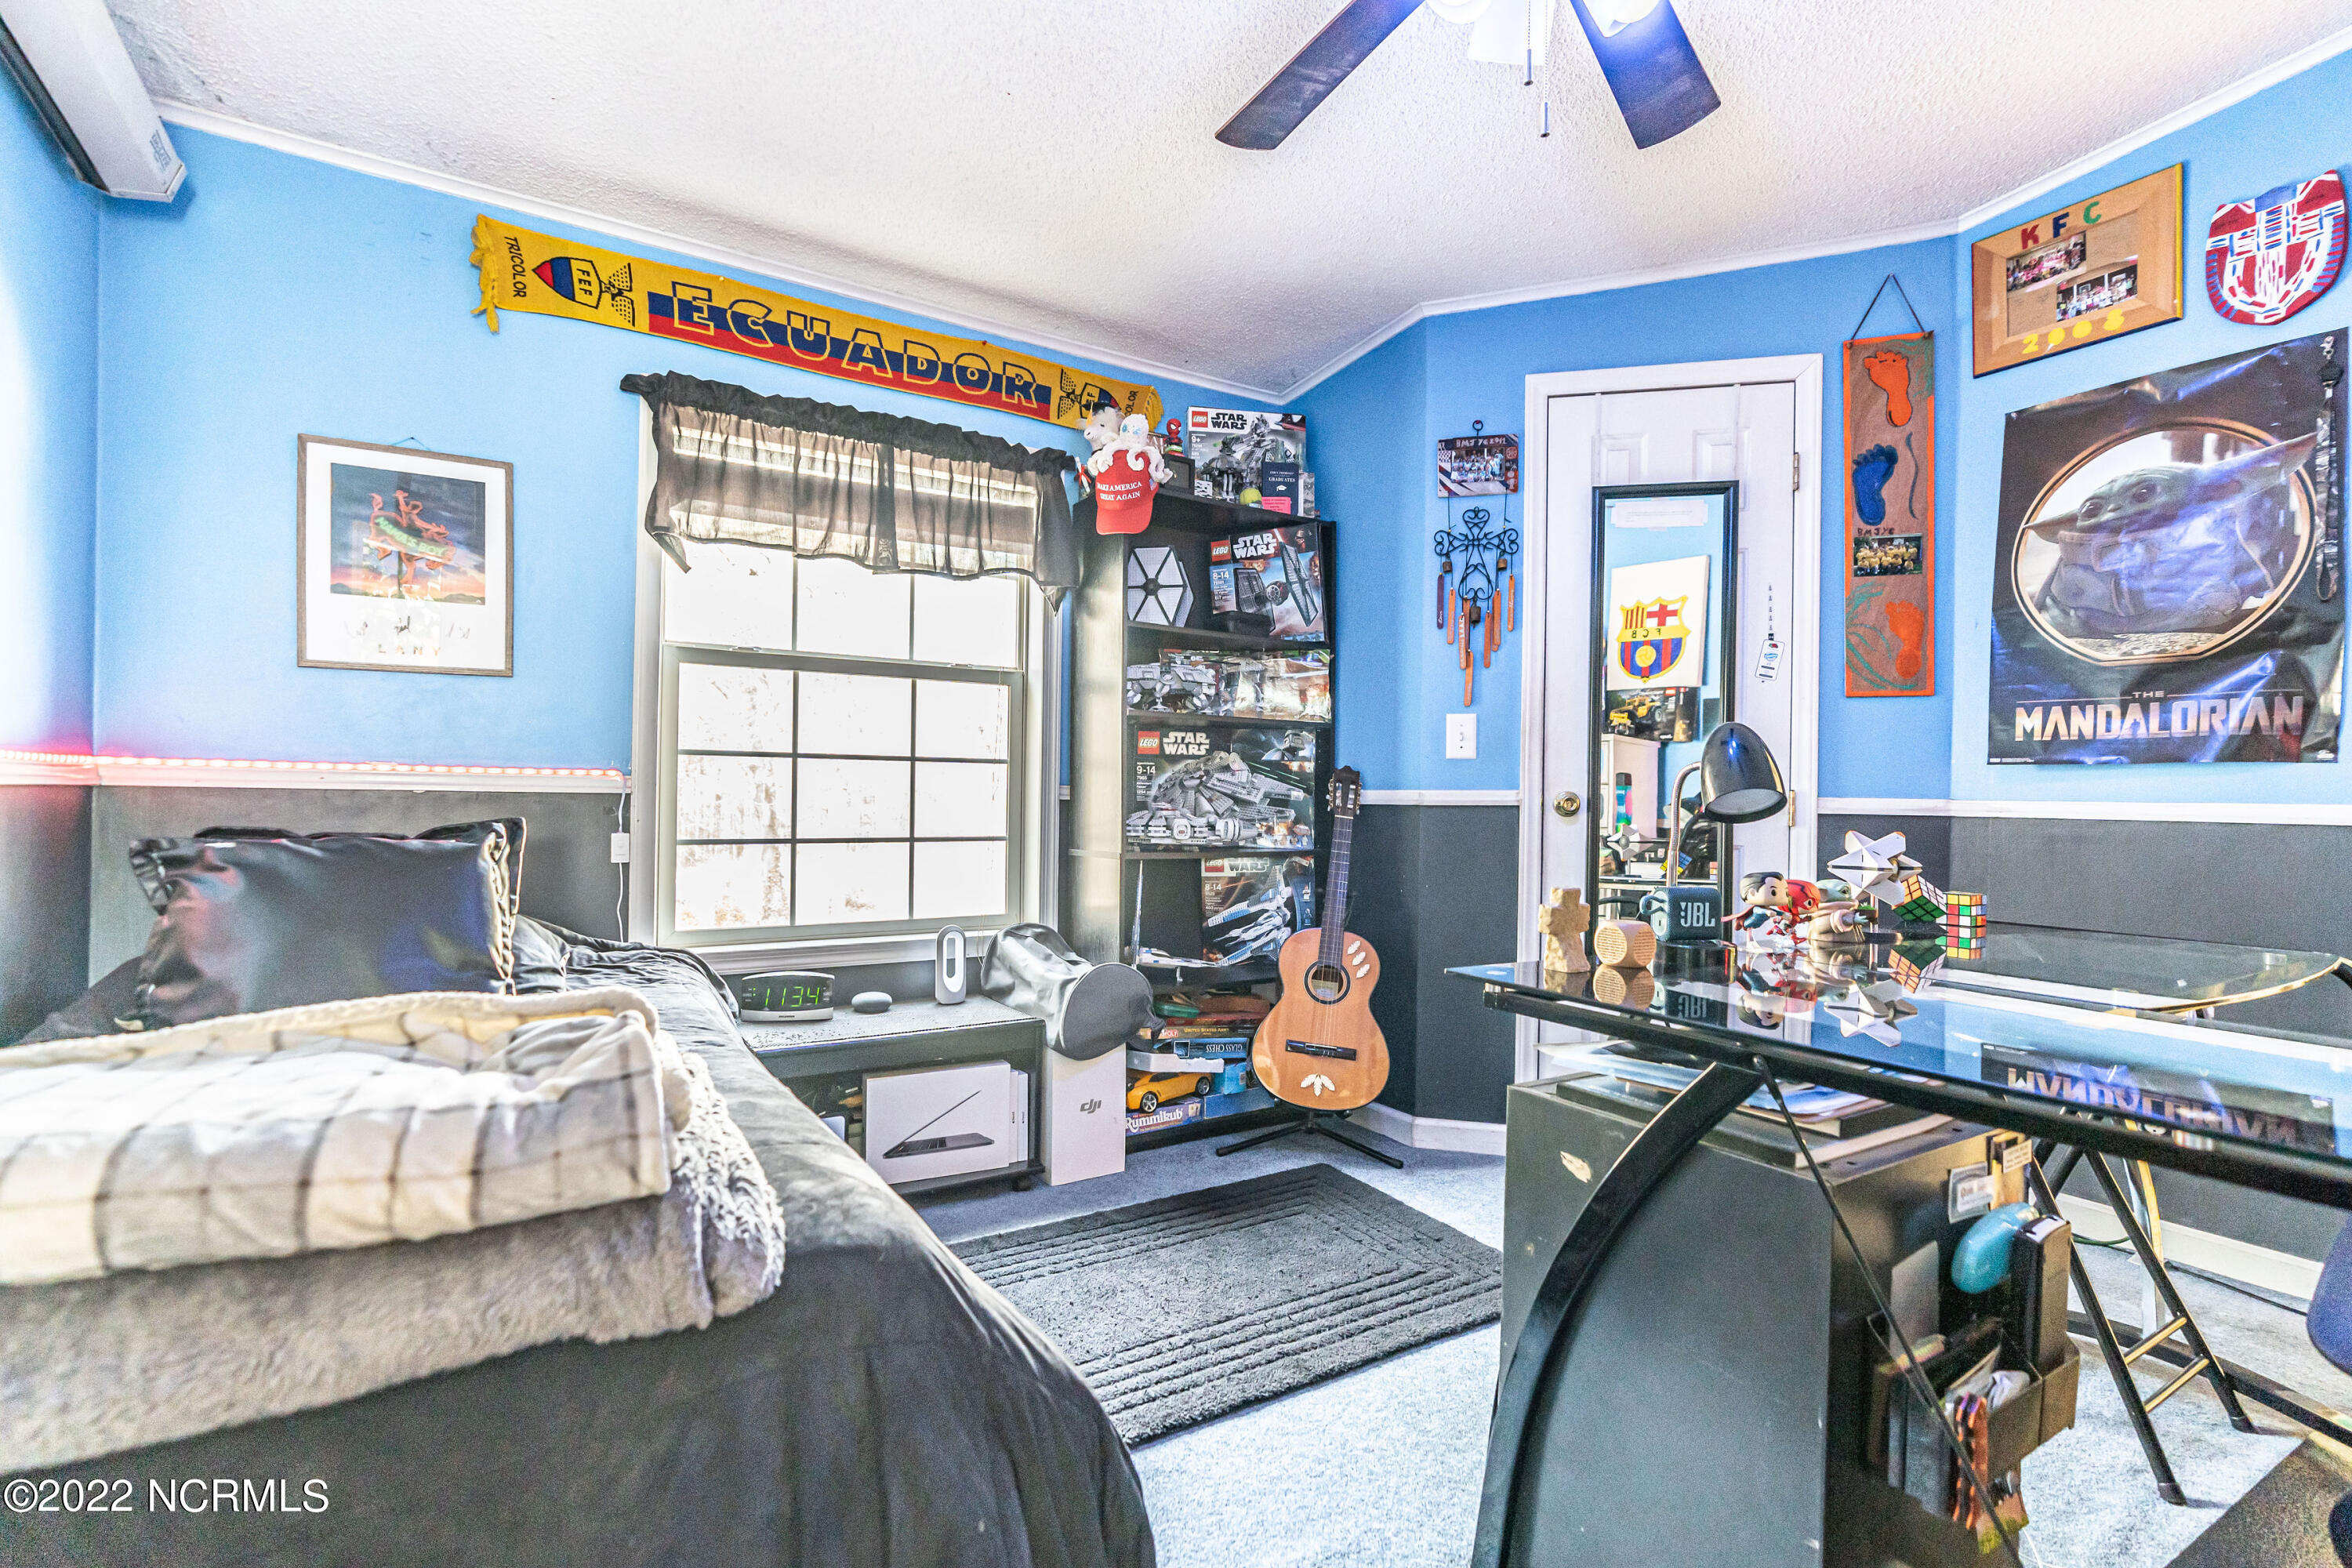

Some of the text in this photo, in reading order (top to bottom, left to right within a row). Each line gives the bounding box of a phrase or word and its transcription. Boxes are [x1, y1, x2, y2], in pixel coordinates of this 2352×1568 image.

[2020, 201, 2101, 249] KFC
[503, 236, 527, 298] TRICOLOR
[576, 267, 593, 296] FEF
[671, 281, 1038, 408] ECUADOR
[1210, 412, 1247, 423] STAR
[1211, 420, 1247, 430] WARS
[1109, 481, 1142, 492] AMERICA
[1116, 491, 1141, 501] AGAIN
[1232, 532, 1277, 549] STAR
[418, 541, 448, 555] BOY
[1212, 546, 1229, 555] LEGO
[1232, 543, 1277, 559] WARS
[1212, 571, 1229, 580] 8-14
[378, 643, 441, 656] LANY
[2132, 690, 2165, 699] THE
[2014, 695, 2303, 742] MANDALORIAN
[1139, 738, 1158, 747] LEGO
[1163, 731, 1210, 744] STAR
[1163, 743, 1210, 756] WARS
[1136, 765, 1156, 775] 9-14
[1228, 861, 1269, 873] WARS
[1680, 902, 1715, 928] JBL
[1206, 1044, 1225, 1053] CHESS
[1225, 1044, 1243, 1052] GLASS
[1080, 1098, 1102, 1115] dji
[1125, 1109, 1183, 1133] Rummikub
